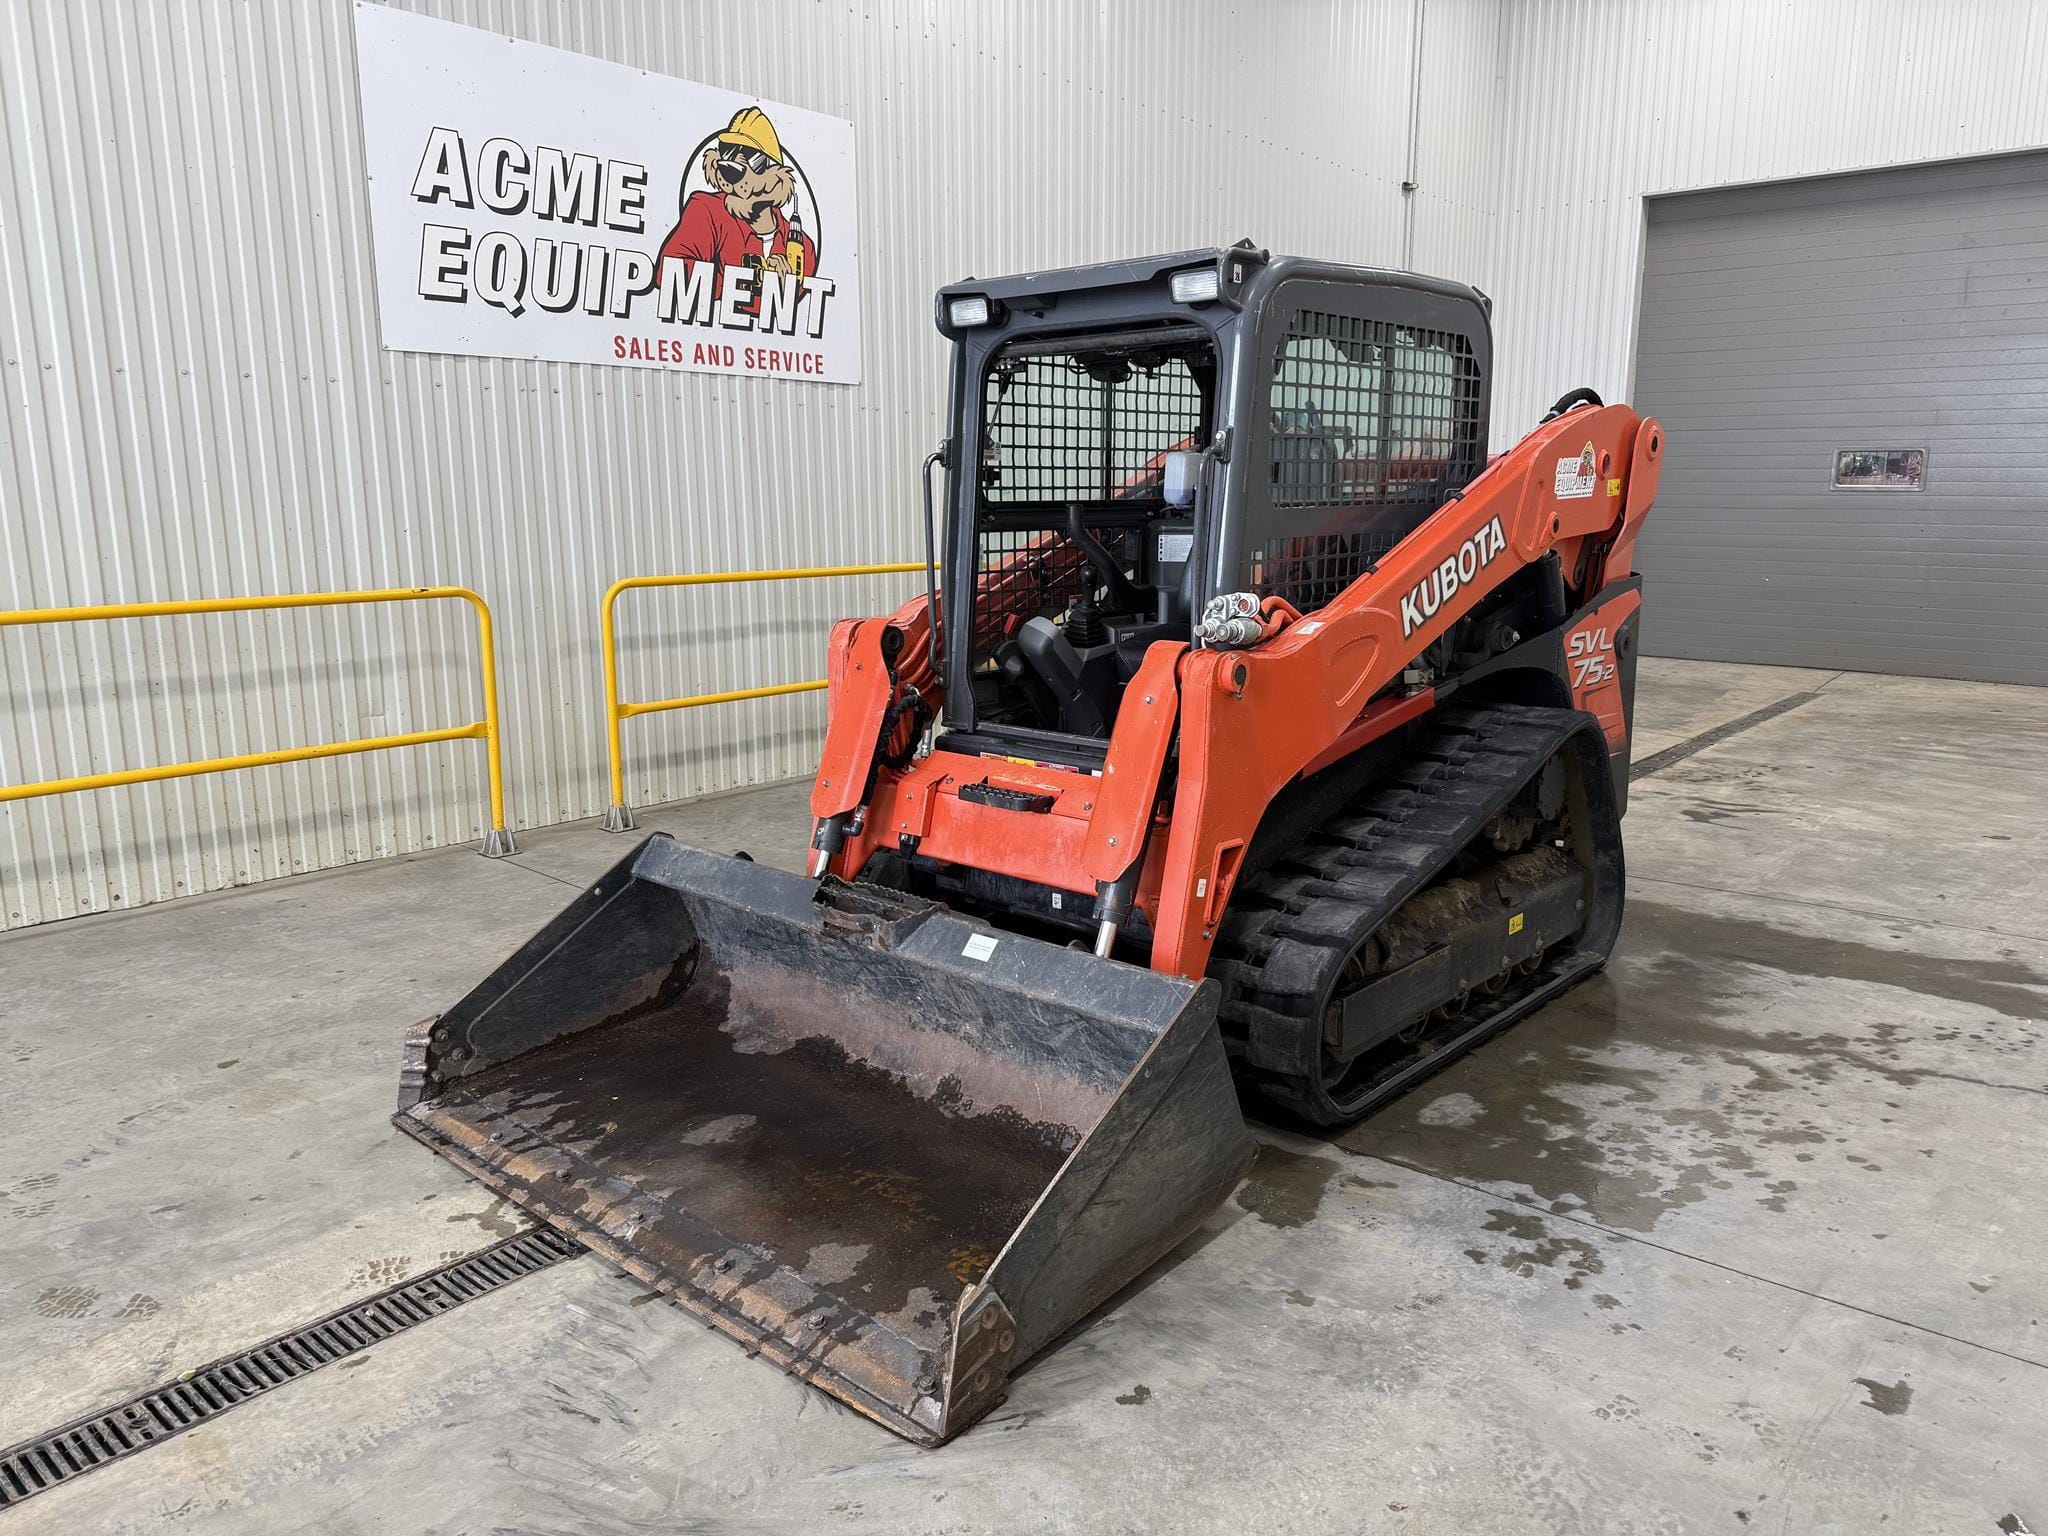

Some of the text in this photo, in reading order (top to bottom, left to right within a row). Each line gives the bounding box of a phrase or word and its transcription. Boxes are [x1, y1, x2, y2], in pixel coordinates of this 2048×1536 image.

[411, 126, 648, 235] ACME
[418, 223, 836, 340] EQUIPMENT
[614, 335, 824, 375] SALES AND SERVICE
[1555, 474, 1596, 492] EQUIPMENT
[1556, 458, 1579, 474] ACME
[1400, 515, 1507, 638] KUBOTA
[1567, 627, 1613, 659] SVL
